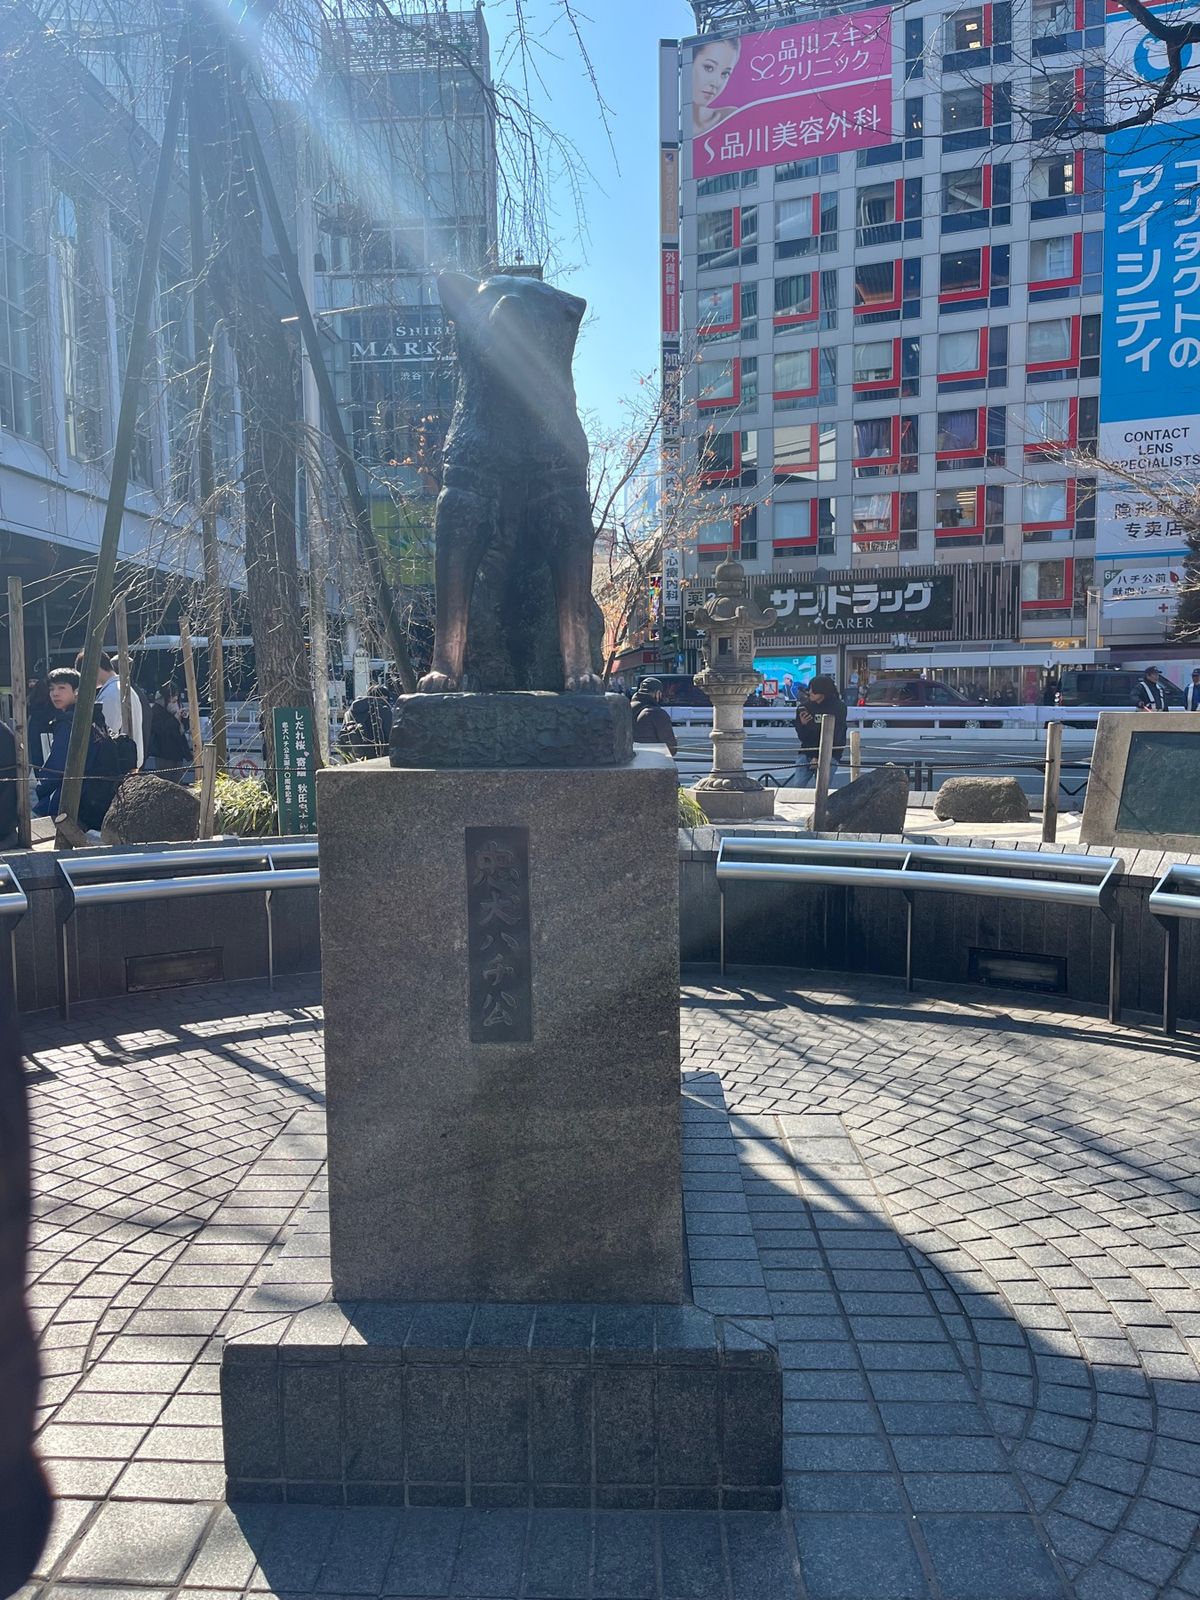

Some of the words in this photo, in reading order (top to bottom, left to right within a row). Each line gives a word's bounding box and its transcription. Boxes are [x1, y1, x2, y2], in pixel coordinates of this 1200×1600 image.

[778, 24, 879, 62] 品川スキン
[778, 50, 870, 86] クリニック
[720, 105, 881, 161] 品川美容外科
[1116, 164, 1164, 373] アイシティ
[665, 427, 678, 435] 5F
[1124, 427, 1190, 443] CONTACT
[1138, 443, 1174, 455] LENS
[1112, 454, 1200, 470] SPECIALISTS
[1124, 521, 1182, 538] 专卖店
[666, 557, 679, 601] 心療内科
[1104, 571, 1117, 580] 6F
[1117, 573, 1167, 585] ハチ公前
[687, 591, 703, 606] 薬
[769, 581, 934, 618] サンドラッグ
[824, 617, 874, 630] CARER
[294, 711, 306, 751] しだれ桜
